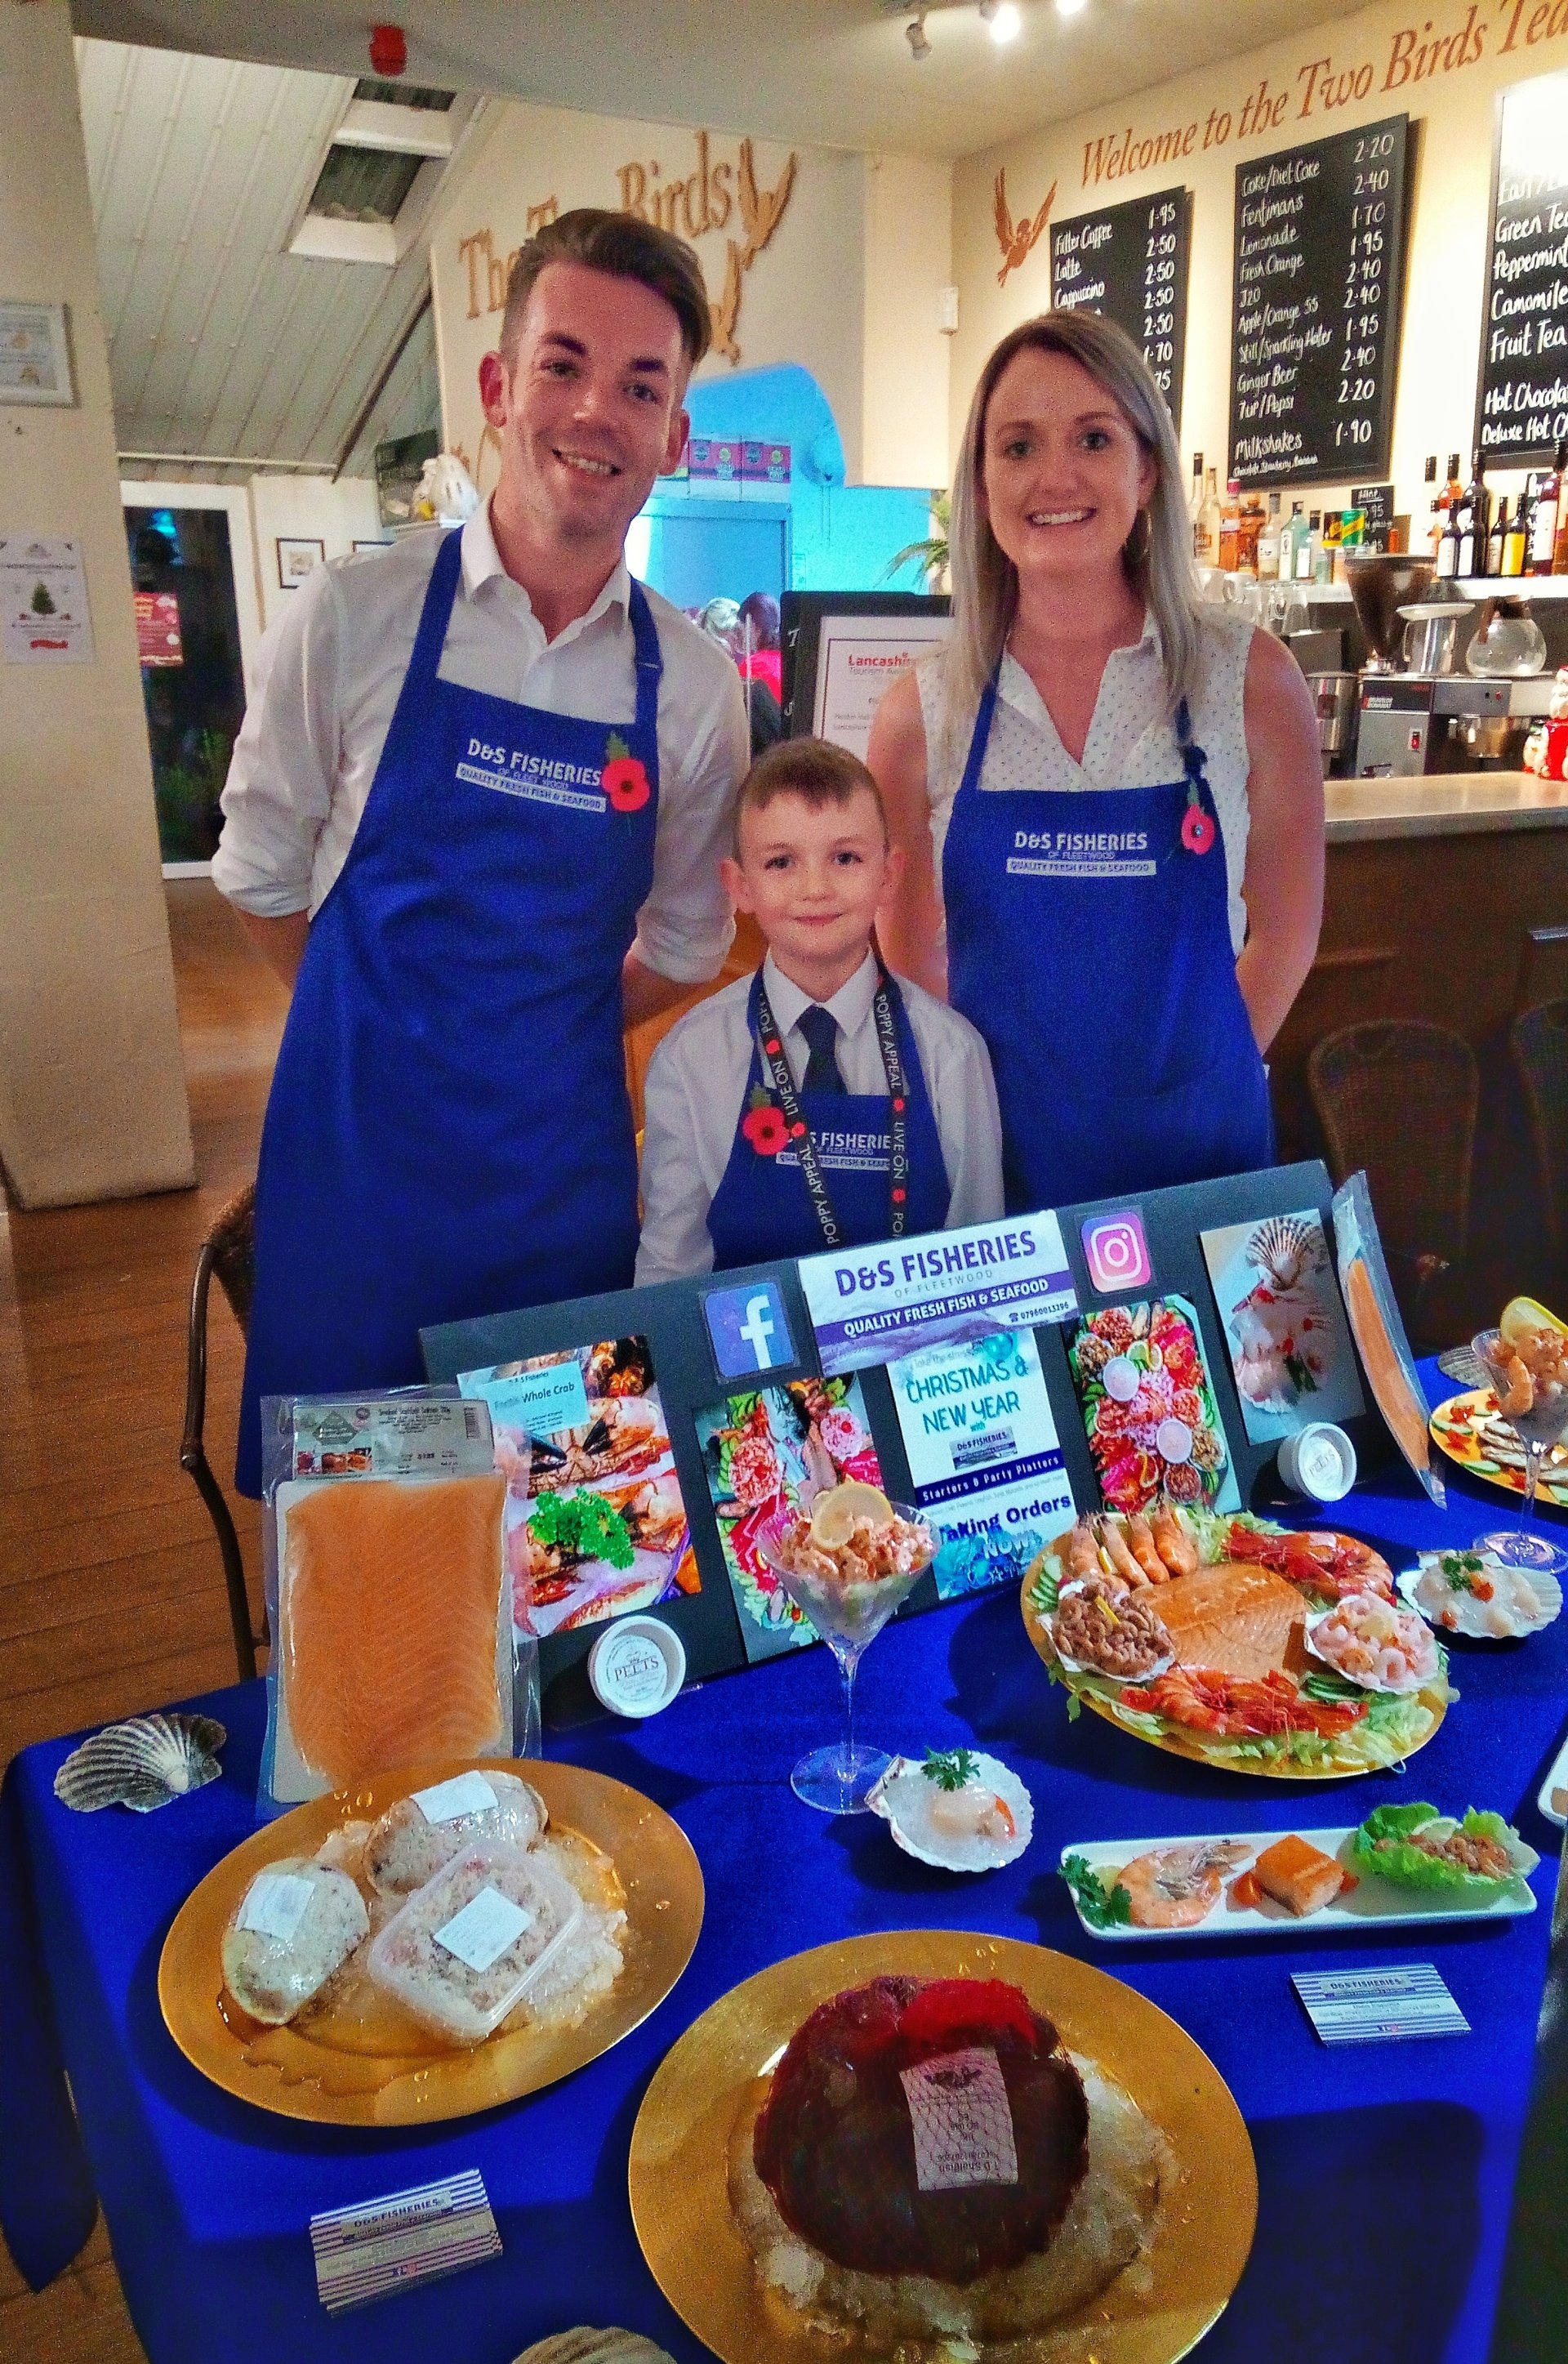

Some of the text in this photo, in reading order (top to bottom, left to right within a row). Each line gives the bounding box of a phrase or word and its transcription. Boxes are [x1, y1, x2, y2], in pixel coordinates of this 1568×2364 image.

[1082, 122, 1198, 190] Welcome
[1202, 109, 1232, 152] to
[1237, 82, 1288, 139] the
[1297, 56, 1374, 119] Two
[1380, 4, 1488, 93] Birds
[1240, 223, 1300, 256] Lemonade
[1495, 215, 1541, 243] Green
[1054, 256, 1082, 282] Latte
[1493, 234, 1568, 282] Peppermint
[1491, 279, 1568, 320] Camomile
[1490, 318, 1567, 363] Fruit Tea
[1485, 377, 1568, 415] Hot Chocola
[1235, 430, 1303, 461] Milkshakes
[1481, 422, 1522, 445] Deluxe
[1526, 413, 1550, 441] Hot
[467, 738, 603, 787] D&S FISHERIES
[1014, 831, 1148, 851] D&S FISHERIES
[875, 994, 893, 1037] POPPY
[773, 1060, 789, 1084] ON
[883, 1040, 902, 1087] APPEAL
[781, 1085, 799, 1115] LIVE
[822, 1132, 891, 1149] FISHERIE
[799, 1144, 825, 1195] APPEAL
[893, 1156, 904, 1180] ON
[813, 1196, 840, 1244] POPPY
[835, 1230, 1036, 1296] D&S FISHERIES
[894, 1269, 993, 1298] OF FLEETWOOD
[844, 1279, 1049, 1337] QUALITY FRESH FISH & SEAFOOD
[523, 1389, 551, 1403] Whole
[553, 1381, 575, 1395] Crab
[906, 1354, 1029, 1404] CHRISTMAS &
[923, 1390, 1021, 1435] NEW YEAR
[923, 1481, 969, 1501] Starters
[984, 1469, 1013, 1485] Party
[1016, 1456, 1059, 1474] Platters
[1006, 1495, 1071, 1523] Orders
